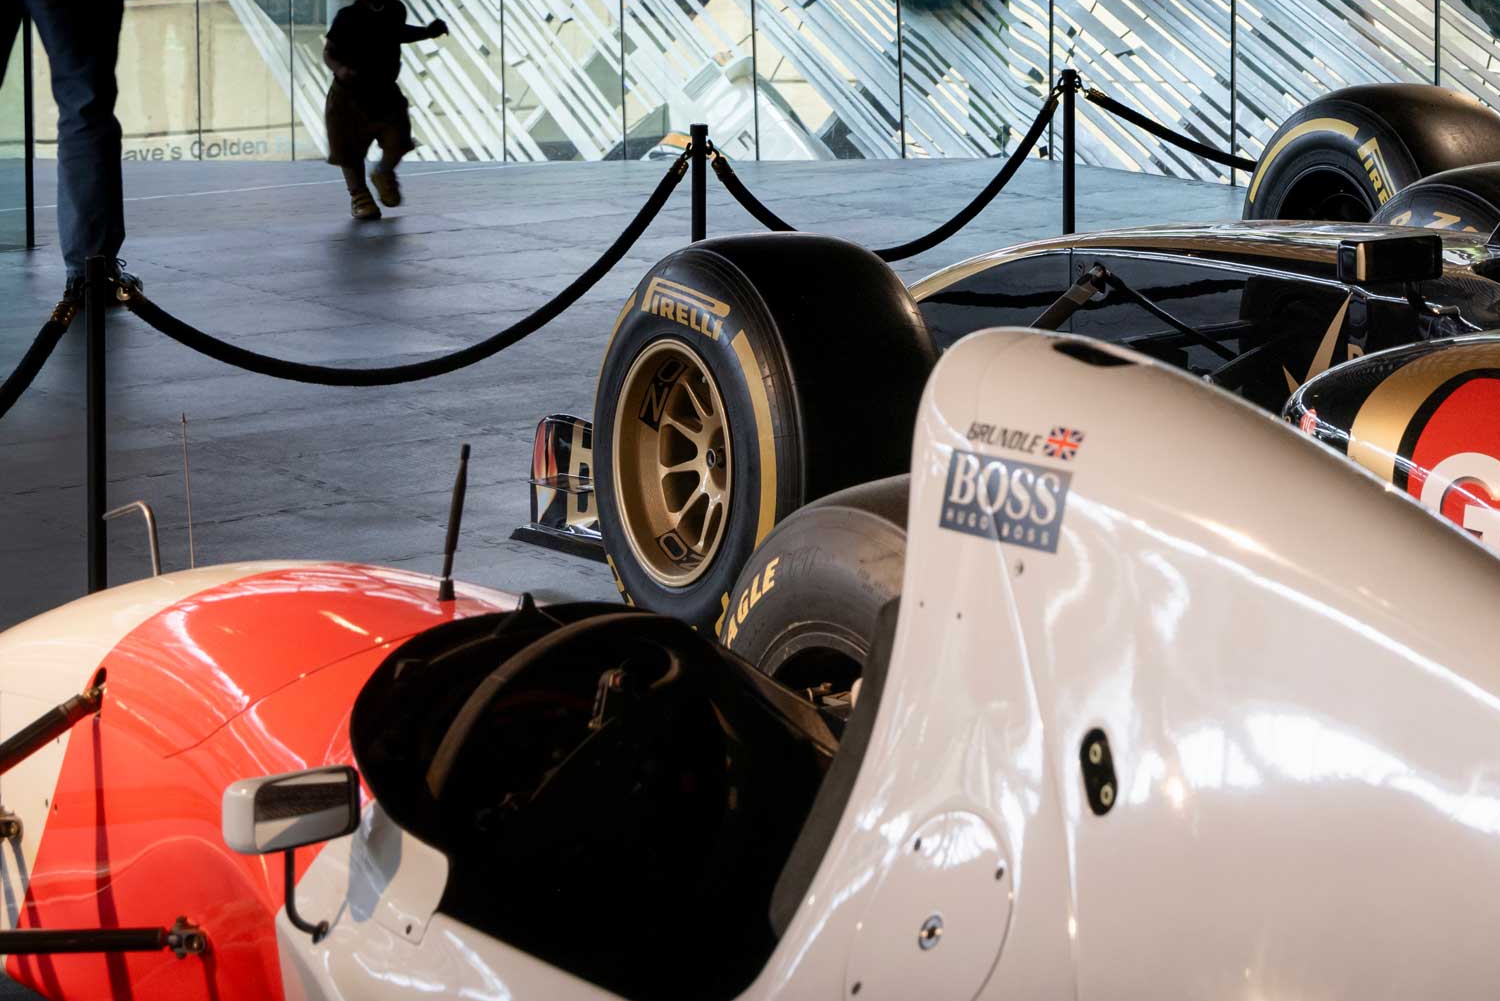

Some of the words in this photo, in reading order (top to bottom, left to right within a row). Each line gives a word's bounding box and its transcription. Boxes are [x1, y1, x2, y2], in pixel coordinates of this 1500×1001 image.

[641, 276, 731, 342] PIRELLI
[948, 452, 1061, 526] BOSS
[722, 556, 780, 650] AGLE
